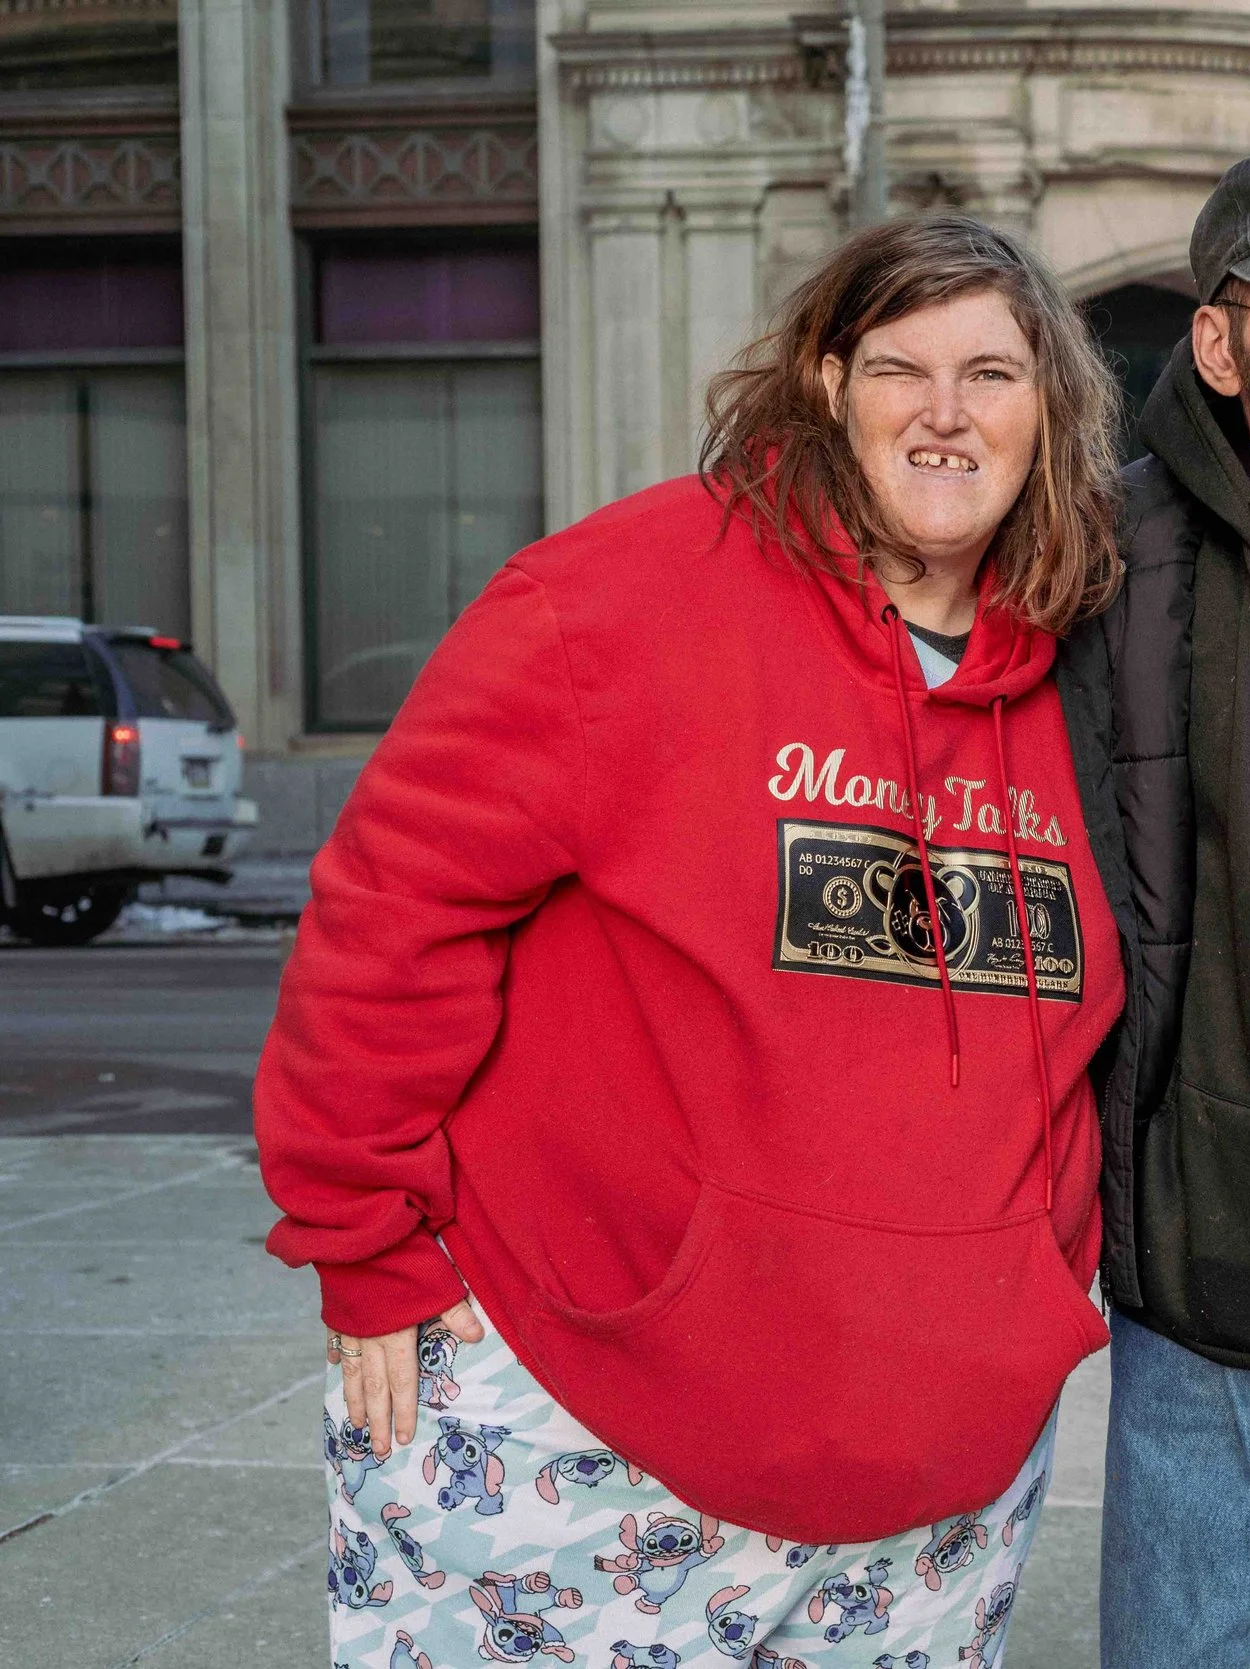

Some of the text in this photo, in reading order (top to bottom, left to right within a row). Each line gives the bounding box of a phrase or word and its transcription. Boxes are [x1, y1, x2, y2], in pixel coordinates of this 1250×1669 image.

[768, 742, 942, 841] Money
[799, 853, 813, 863] AB
[815, 854, 863, 869] 01234567
[1005, 885, 1057, 901] AERICA
[807, 941, 865, 962] 100
[991, 937, 1055, 953] AB 0123567 C
[1034, 955, 1075, 975] 100
